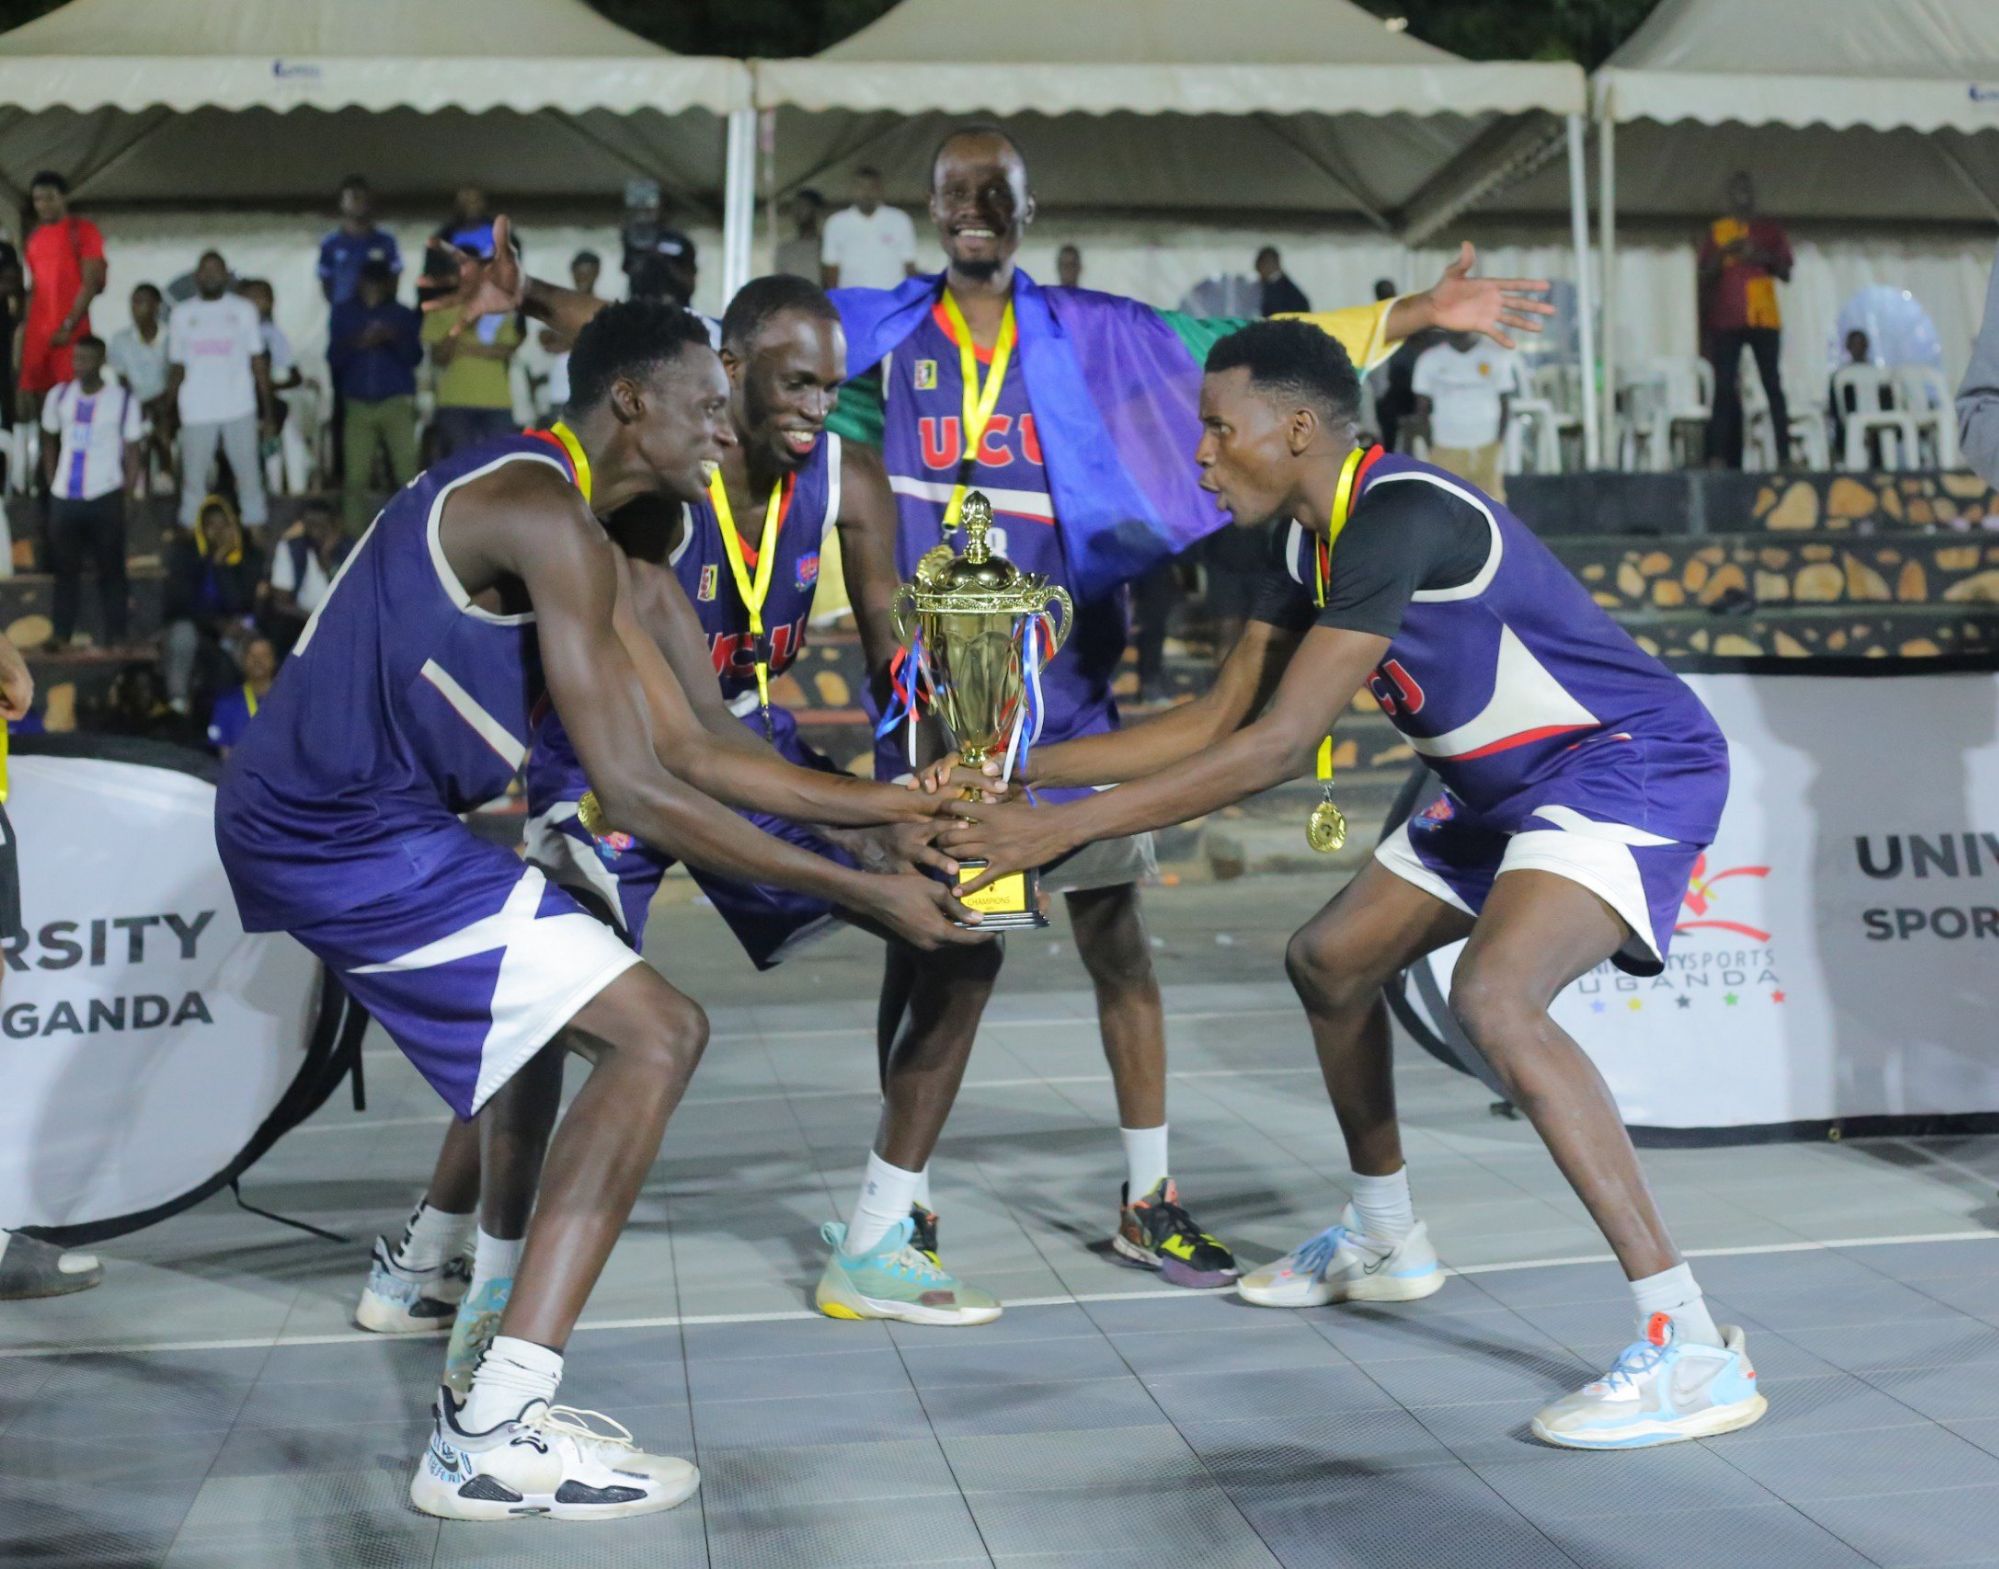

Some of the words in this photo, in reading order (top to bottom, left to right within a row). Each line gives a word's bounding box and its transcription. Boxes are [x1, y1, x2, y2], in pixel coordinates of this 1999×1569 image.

[1862, 906, 1999, 941] SPOR
[1579, 969, 1780, 994] UGANDA
[2, 990, 214, 1040] GANDA
